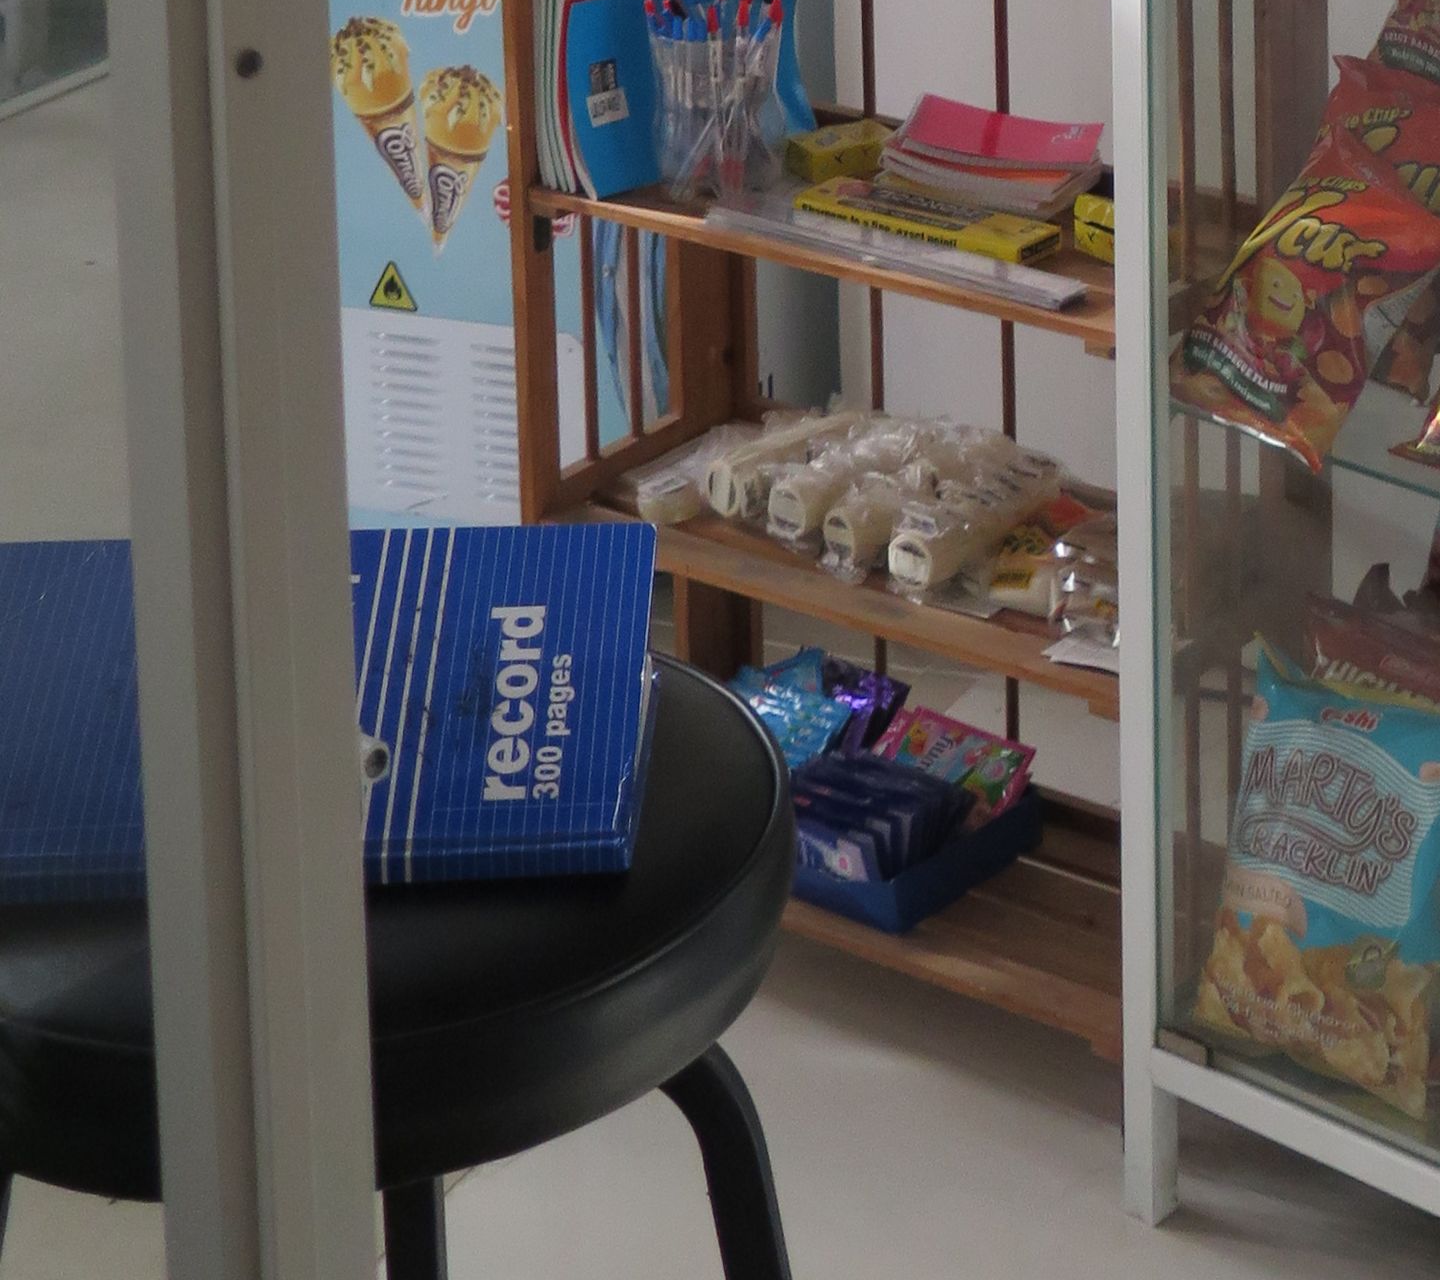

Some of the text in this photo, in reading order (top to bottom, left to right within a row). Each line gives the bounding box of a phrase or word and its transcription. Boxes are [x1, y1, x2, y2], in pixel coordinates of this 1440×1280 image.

[483, 604, 547, 802] record
[546, 653, 577, 737] pages
[532, 744, 563, 801] 300
